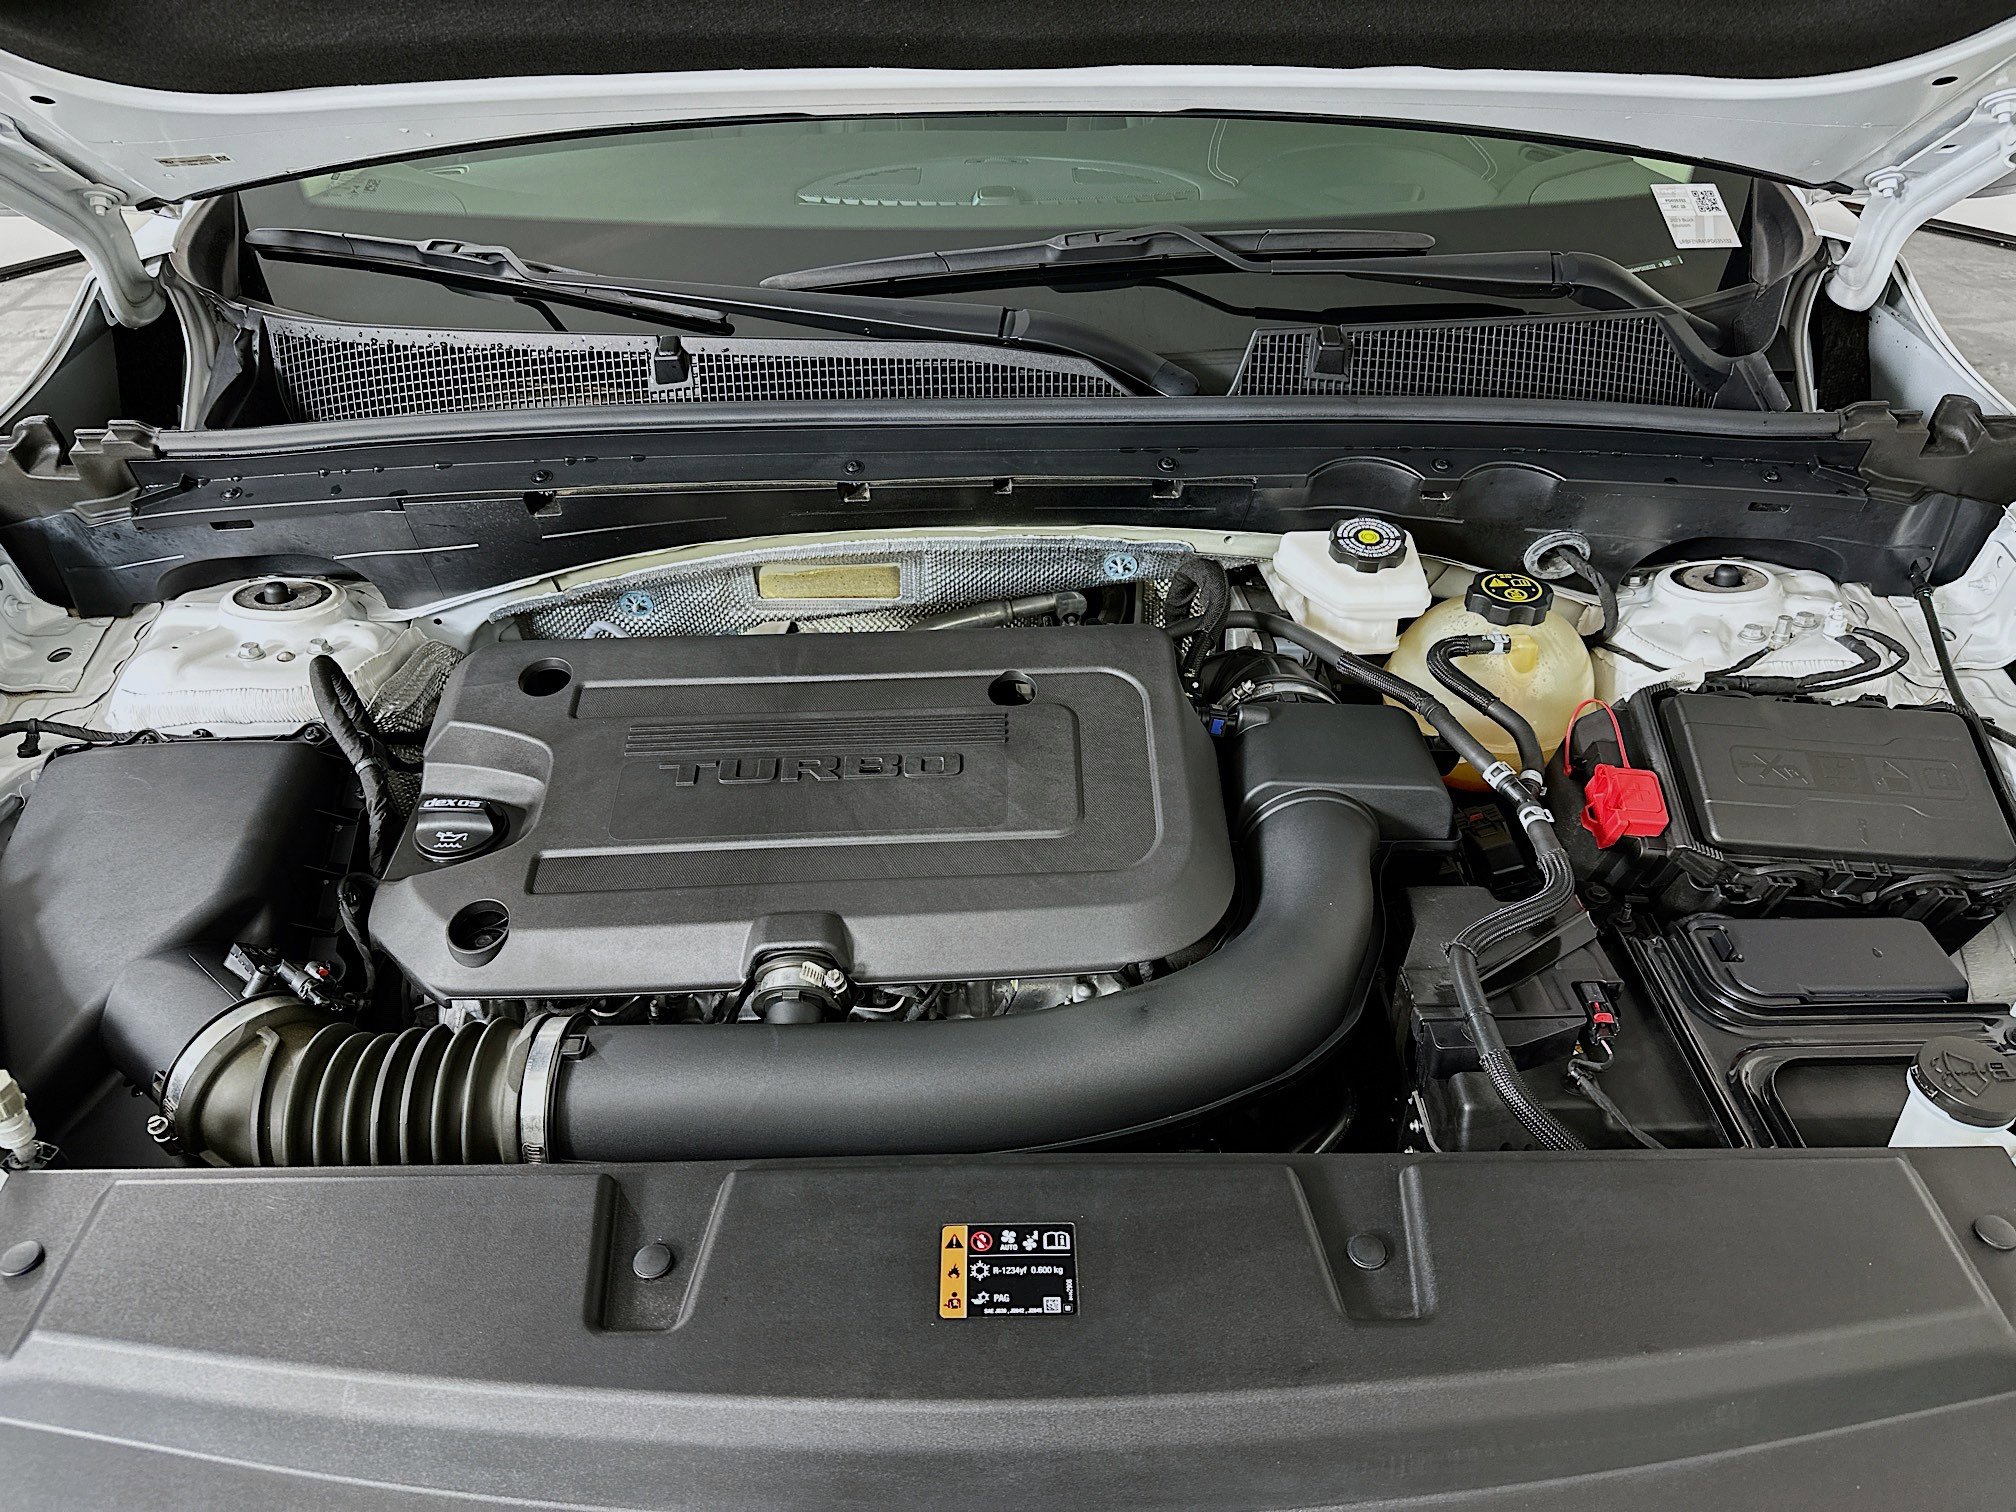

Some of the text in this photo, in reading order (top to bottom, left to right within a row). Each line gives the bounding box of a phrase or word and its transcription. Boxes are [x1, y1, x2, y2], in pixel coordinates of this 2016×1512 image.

[659, 753, 964, 787] TURBO
[423, 798, 482, 808] dexos
[992, 1266, 1064, 1275] R-1234yf 0.600 kg
[993, 1294, 1010, 1302] PAG
